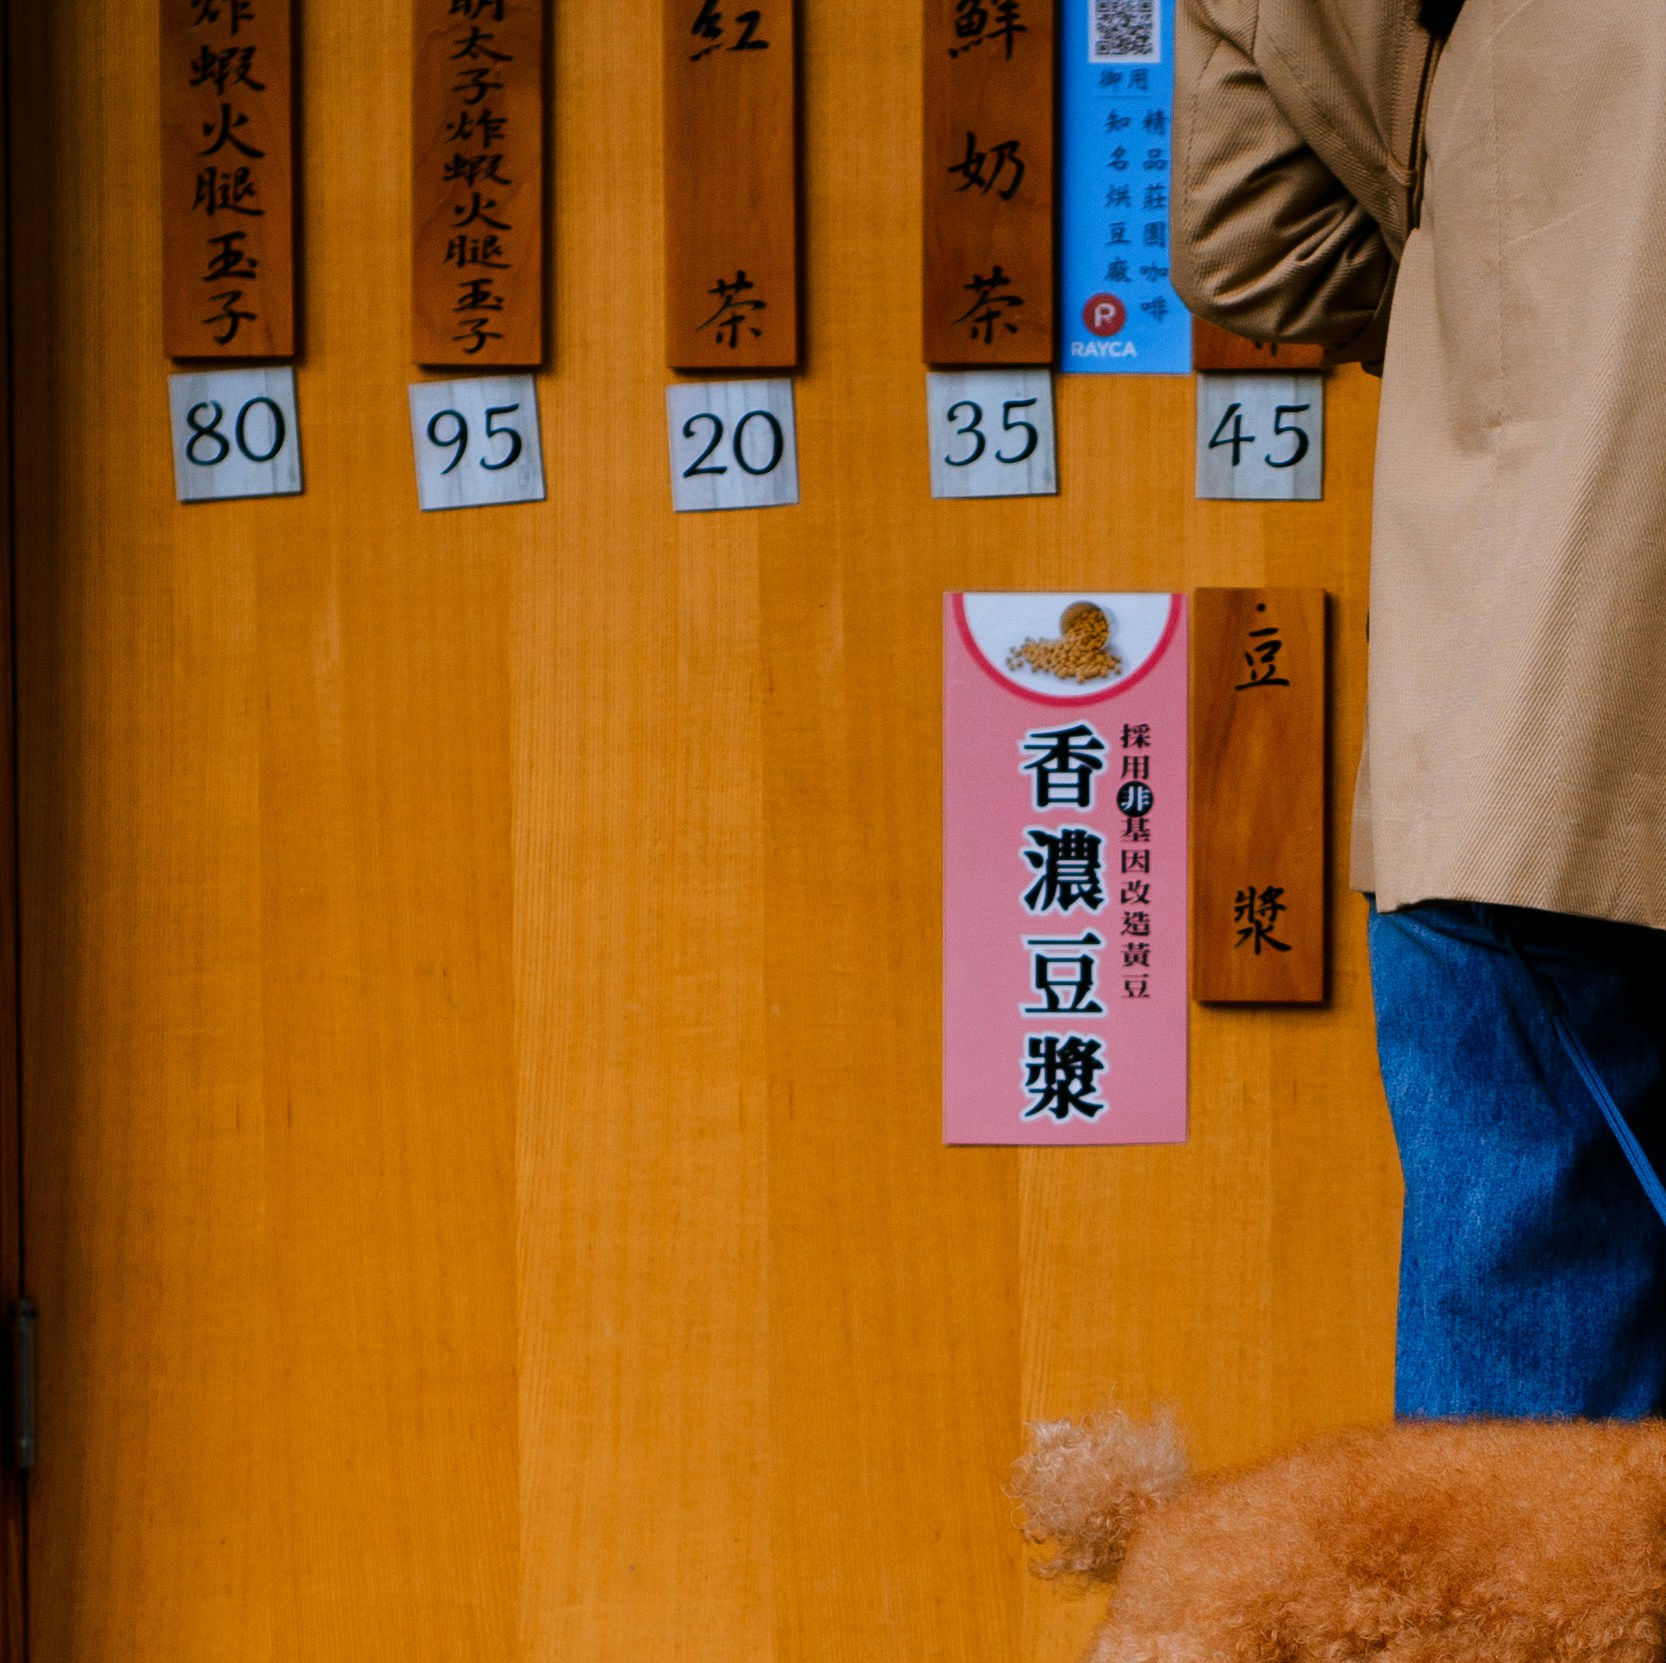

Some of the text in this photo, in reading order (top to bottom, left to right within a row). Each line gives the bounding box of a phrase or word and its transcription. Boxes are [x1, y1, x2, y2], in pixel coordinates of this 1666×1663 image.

[1071, 341, 1137, 357] RAYCA
[184, 396, 287, 468] 80
[426, 402, 523, 476] 95
[681, 409, 784, 479] 20
[943, 398, 1040, 467] 35
[1208, 402, 1311, 468] 45
[1234, 627, 1291, 956] 豆漿
[1117, 723, 1154, 999] 採用非基因改造黃豆
[1021, 723, 1106, 1120] 香濃豆漿
